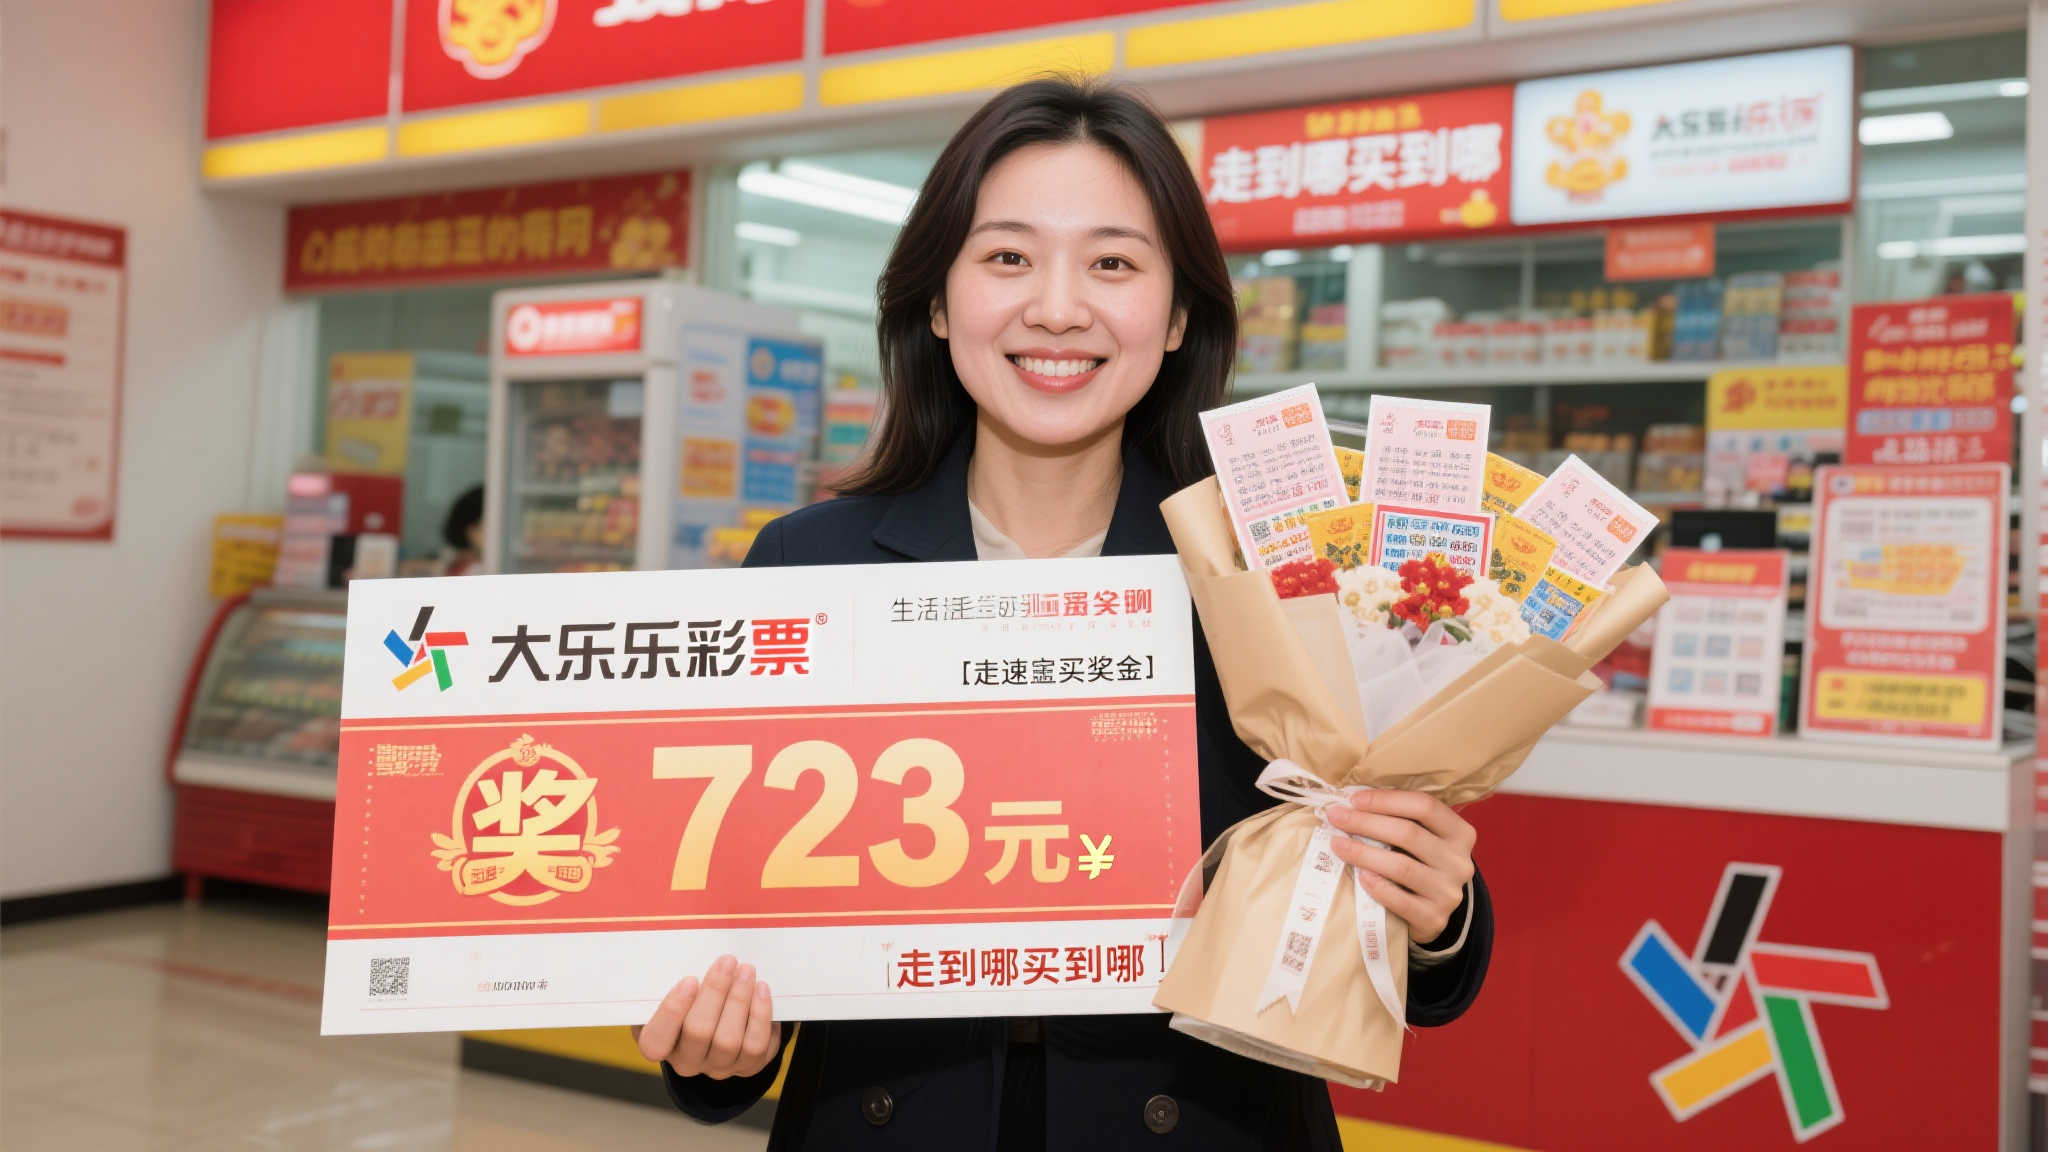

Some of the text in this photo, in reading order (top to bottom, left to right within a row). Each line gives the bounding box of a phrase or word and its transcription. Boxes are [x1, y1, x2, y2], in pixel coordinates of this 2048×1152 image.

[1208, 123, 1504, 204] 走到哪买到哪
[488, 617, 811, 683] 大乐乐彩票
[460, 768, 599, 895] 奖
[896, 943, 1145, 989] 走到哪买到哪
